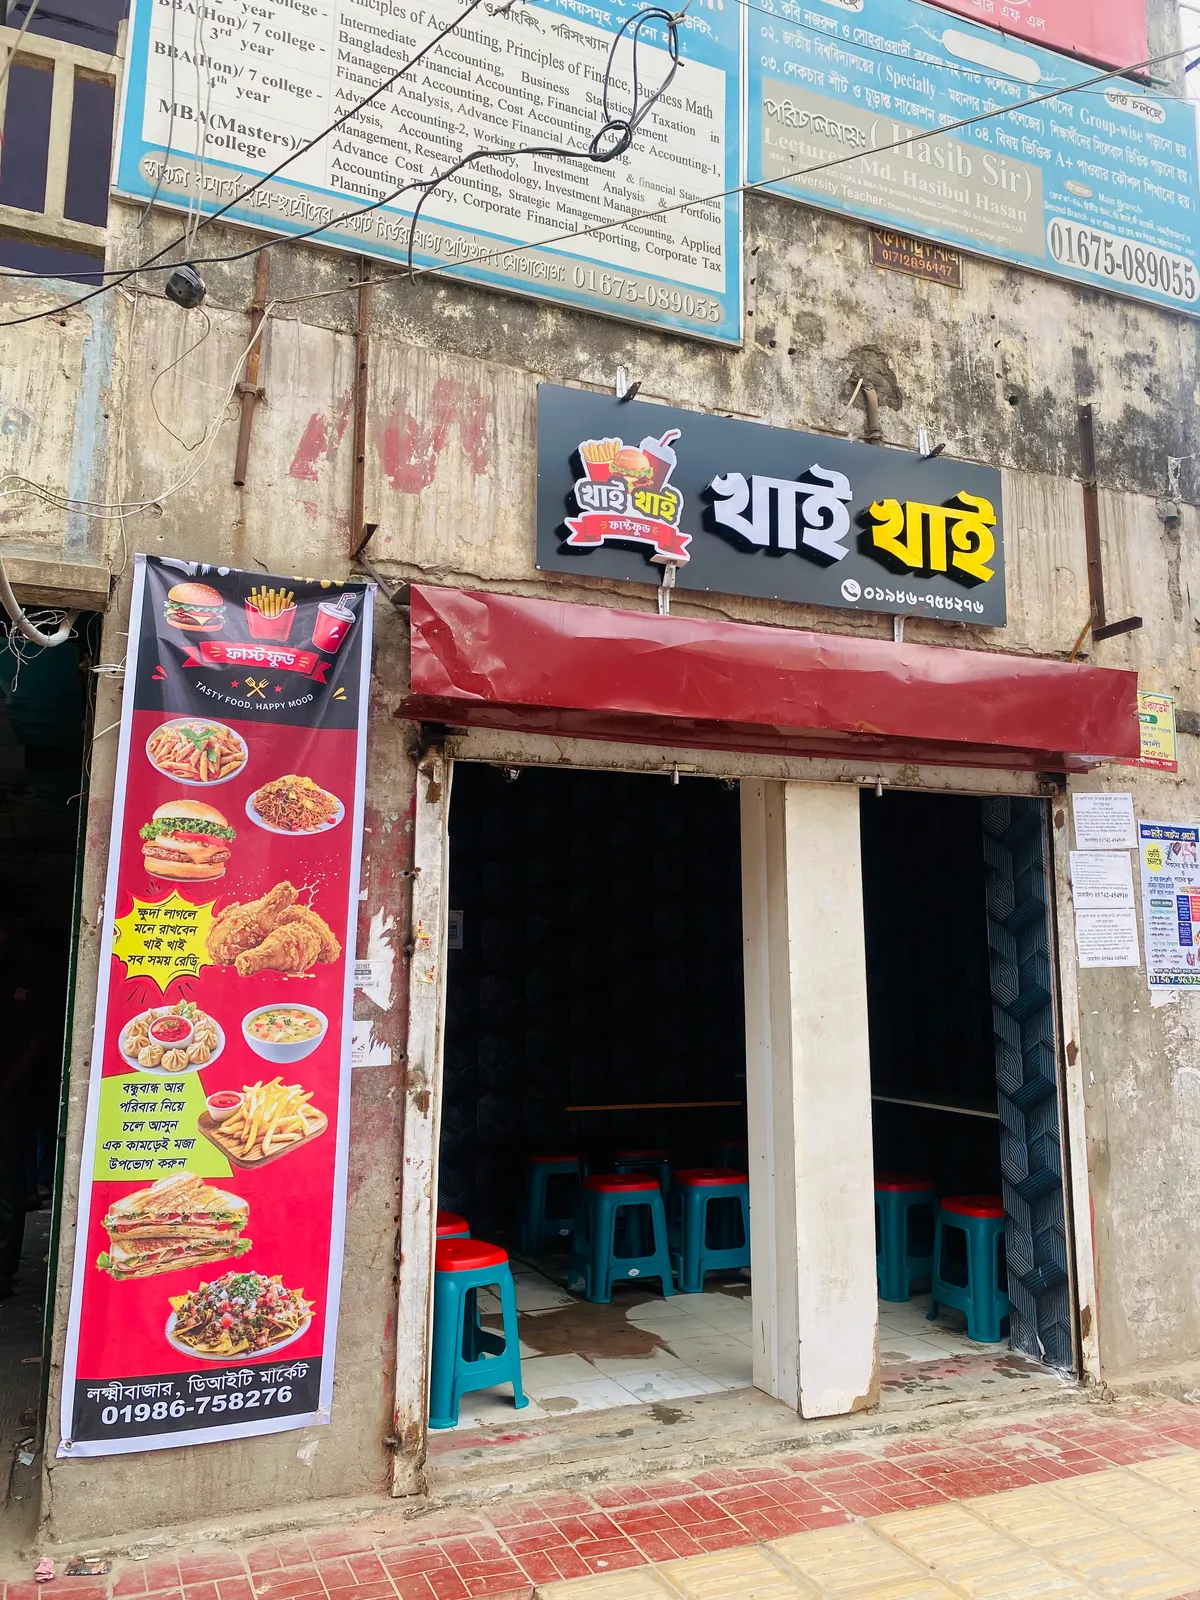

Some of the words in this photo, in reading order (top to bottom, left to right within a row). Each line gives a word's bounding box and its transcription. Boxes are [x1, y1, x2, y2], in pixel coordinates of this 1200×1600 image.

[241, 2, 276, 21] year
[1000, 6, 1021, 22] এফ
[1026, 15, 1046, 32] এল
[209, 27, 232, 40] 3rd
[240, 38, 275, 57] year
[252, 22, 261, 34] 7
[265, 27, 316, 53] college
[551, 22, 611, 54] পরিসংখ্যান
[154, 40, 245, 79] BBA(Hon)/
[248, 68, 258, 82] 7
[261, 74, 313, 99] college
[338, 30, 410, 63] Bangladesh
[416, 55, 472, 83] Financial
[474, 74, 544, 107] Accounting,
[546, 96, 597, 121] Financial
[339, 12, 417, 47] Intermediate
[433, 44, 505, 77] Accounting,
[521, 71, 570, 96] Business
[651, 111, 696, 137] Taxation
[710, 131, 720, 144] in
[410, 11, 425, 24] of
[427, 14, 502, 53] Accounting,
[506, 39, 565, 71] Principles
[568, 60, 582, 75] of
[584, 64, 631, 95] Finance,
[636, 81, 682, 109] Business
[685, 97, 714, 120] Math
[781, 1, 801, 21] কবি
[805, 10, 838, 35] নজরুল
[842, 25, 850, 38] ও
[1079, 107, 1143, 143] Group-wise
[1145, 131, 1173, 154] পড়ানো
[206, 75, 228, 89] 4th
[236, 86, 271, 104] year
[336, 65, 394, 93] Financial
[397, 84, 454, 113] Analysis,
[456, 102, 509, 128] Advance
[511, 120, 563, 145] Financial
[761, 26, 779, 43] ০২.
[781, 30, 812, 53] জাতীয়
[814, 37, 875, 75] বিশ্ববিদ্যালয়ের
[886, 64, 937, 101] Specially
[948, 87, 980, 111] মহানগর
[1092, 134, 1124, 161] সিলেবাস
[1150, 158, 1176, 178] পড়ানো
[337, 48, 418, 83] Management
[421, 75, 494, 109] Accounting,
[497, 97, 524, 116] Cost
[527, 108, 595, 138] Accounting,
[648, 144, 722, 177] Accounting-1,
[1131, 98, 1163, 122] চলছে
[204, 132, 268, 159] college
[335, 86, 387, 111] Advance
[390, 103, 469, 138] Accounting-2,
[472, 126, 516, 151] Working
[555, 154, 616, 179] Management
[626, 173, 635, 185] &
[638, 177, 676, 198] financial
[760, 55, 780, 73] ০৩.
[783, 60, 825, 88] লেকচার
[828, 70, 849, 93] শীট
[852, 85, 862, 98] ও
[893, 95, 935, 124] সাজেশন
[974, 126, 993, 144] ০৪.
[996, 128, 1019, 152] বিষয়
[1055, 153, 1074, 170] A+
[1077, 158, 1109, 183] পাওয়ার
[1112, 168, 1141, 193] কৌশল
[1143, 176, 1176, 205] শিখানো
[333, 119, 411, 155] Management,
[467, 158, 542, 190] Methodology,
[545, 180, 601, 207] Investment
[334, 104, 383, 130] Analysis,
[398, 122, 464, 153] Accounting
[533, 160, 590, 187] Investment
[602, 182, 646, 203] Analysis
[658, 197, 668, 209] &
[680, 204, 722, 225] Portfolio
[764, 126, 853, 170] Lecturer:
[860, 157, 897, 183] Md.
[902, 168, 970, 206] Hasibul
[975, 192, 1028, 223] Hasan
[891, 123, 973, 179] Hasib
[982, 153, 1033, 204] Sir)
[330, 173, 387, 202] Planning
[332, 138, 389, 164] Advance
[395, 156, 424, 173] Cost
[508, 188, 551, 210] Strategic
[555, 200, 616, 226] Management
[620, 221, 675, 245] Accounting,
[680, 235, 721, 257] Applied
[841, 184, 887, 207] Teacher:
[1097, 193, 1115, 206] Main
[331, 156, 405, 189] Accounting
[463, 192, 521, 221] Corporate
[526, 209, 578, 233] Financial
[583, 223, 640, 253] Reporting,
[645, 242, 698, 266] Corporate
[701, 256, 722, 273] Tax
[1044, 201, 1066, 215] Second
[1050, 222, 1196, 300] 01675-089055
[572, 265, 721, 323] 01675-089055
[581, 480, 626, 511] খাই
[634, 490, 677, 521] খাই
[608, 519, 652, 536] ফাস্টফুড
[712, 462, 853, 561] খাই
[869, 489, 997, 583] খাই
[863, 586, 985, 614] ০১৯৮৬-৭৫৮২৭৬
[195, 680, 223, 702] TASTY
[256, 701, 286, 712] HAPPY
[288, 693, 315, 708] MOOD
[134, 923, 157, 934] মনে
[159, 924, 198, 936] রাখবেন
[137, 907, 161, 922] ক্ষুদা
[163, 909, 198, 921] লাগলে
[143, 936, 164, 951] খাই
[167, 937, 187, 951] খাই
[127, 955, 145, 966] সব
[147, 955, 173, 966] সময়
[174, 953, 200, 967] রেডি
[164, 1082, 186, 1093] আর
[119, 1099, 158, 1113] পরিবার
[160, 1098, 186, 1112] নিয়ে
[122, 1121, 145, 1132] চলে
[148, 1120, 180, 1133] আসুন
[102, 1139, 123, 1151] এক
[126, 1136, 171, 1153] কামড়েই
[174, 1138, 197, 1150] মজা
[109, 1156, 155, 1171] উপভোগ
[157, 1157, 188, 1168] করুন
[187, 1369, 256, 1394] ডিআইটি
[260, 1361, 310, 1385] মার্কেট
[101, 1385, 293, 1425] 01986-758276
